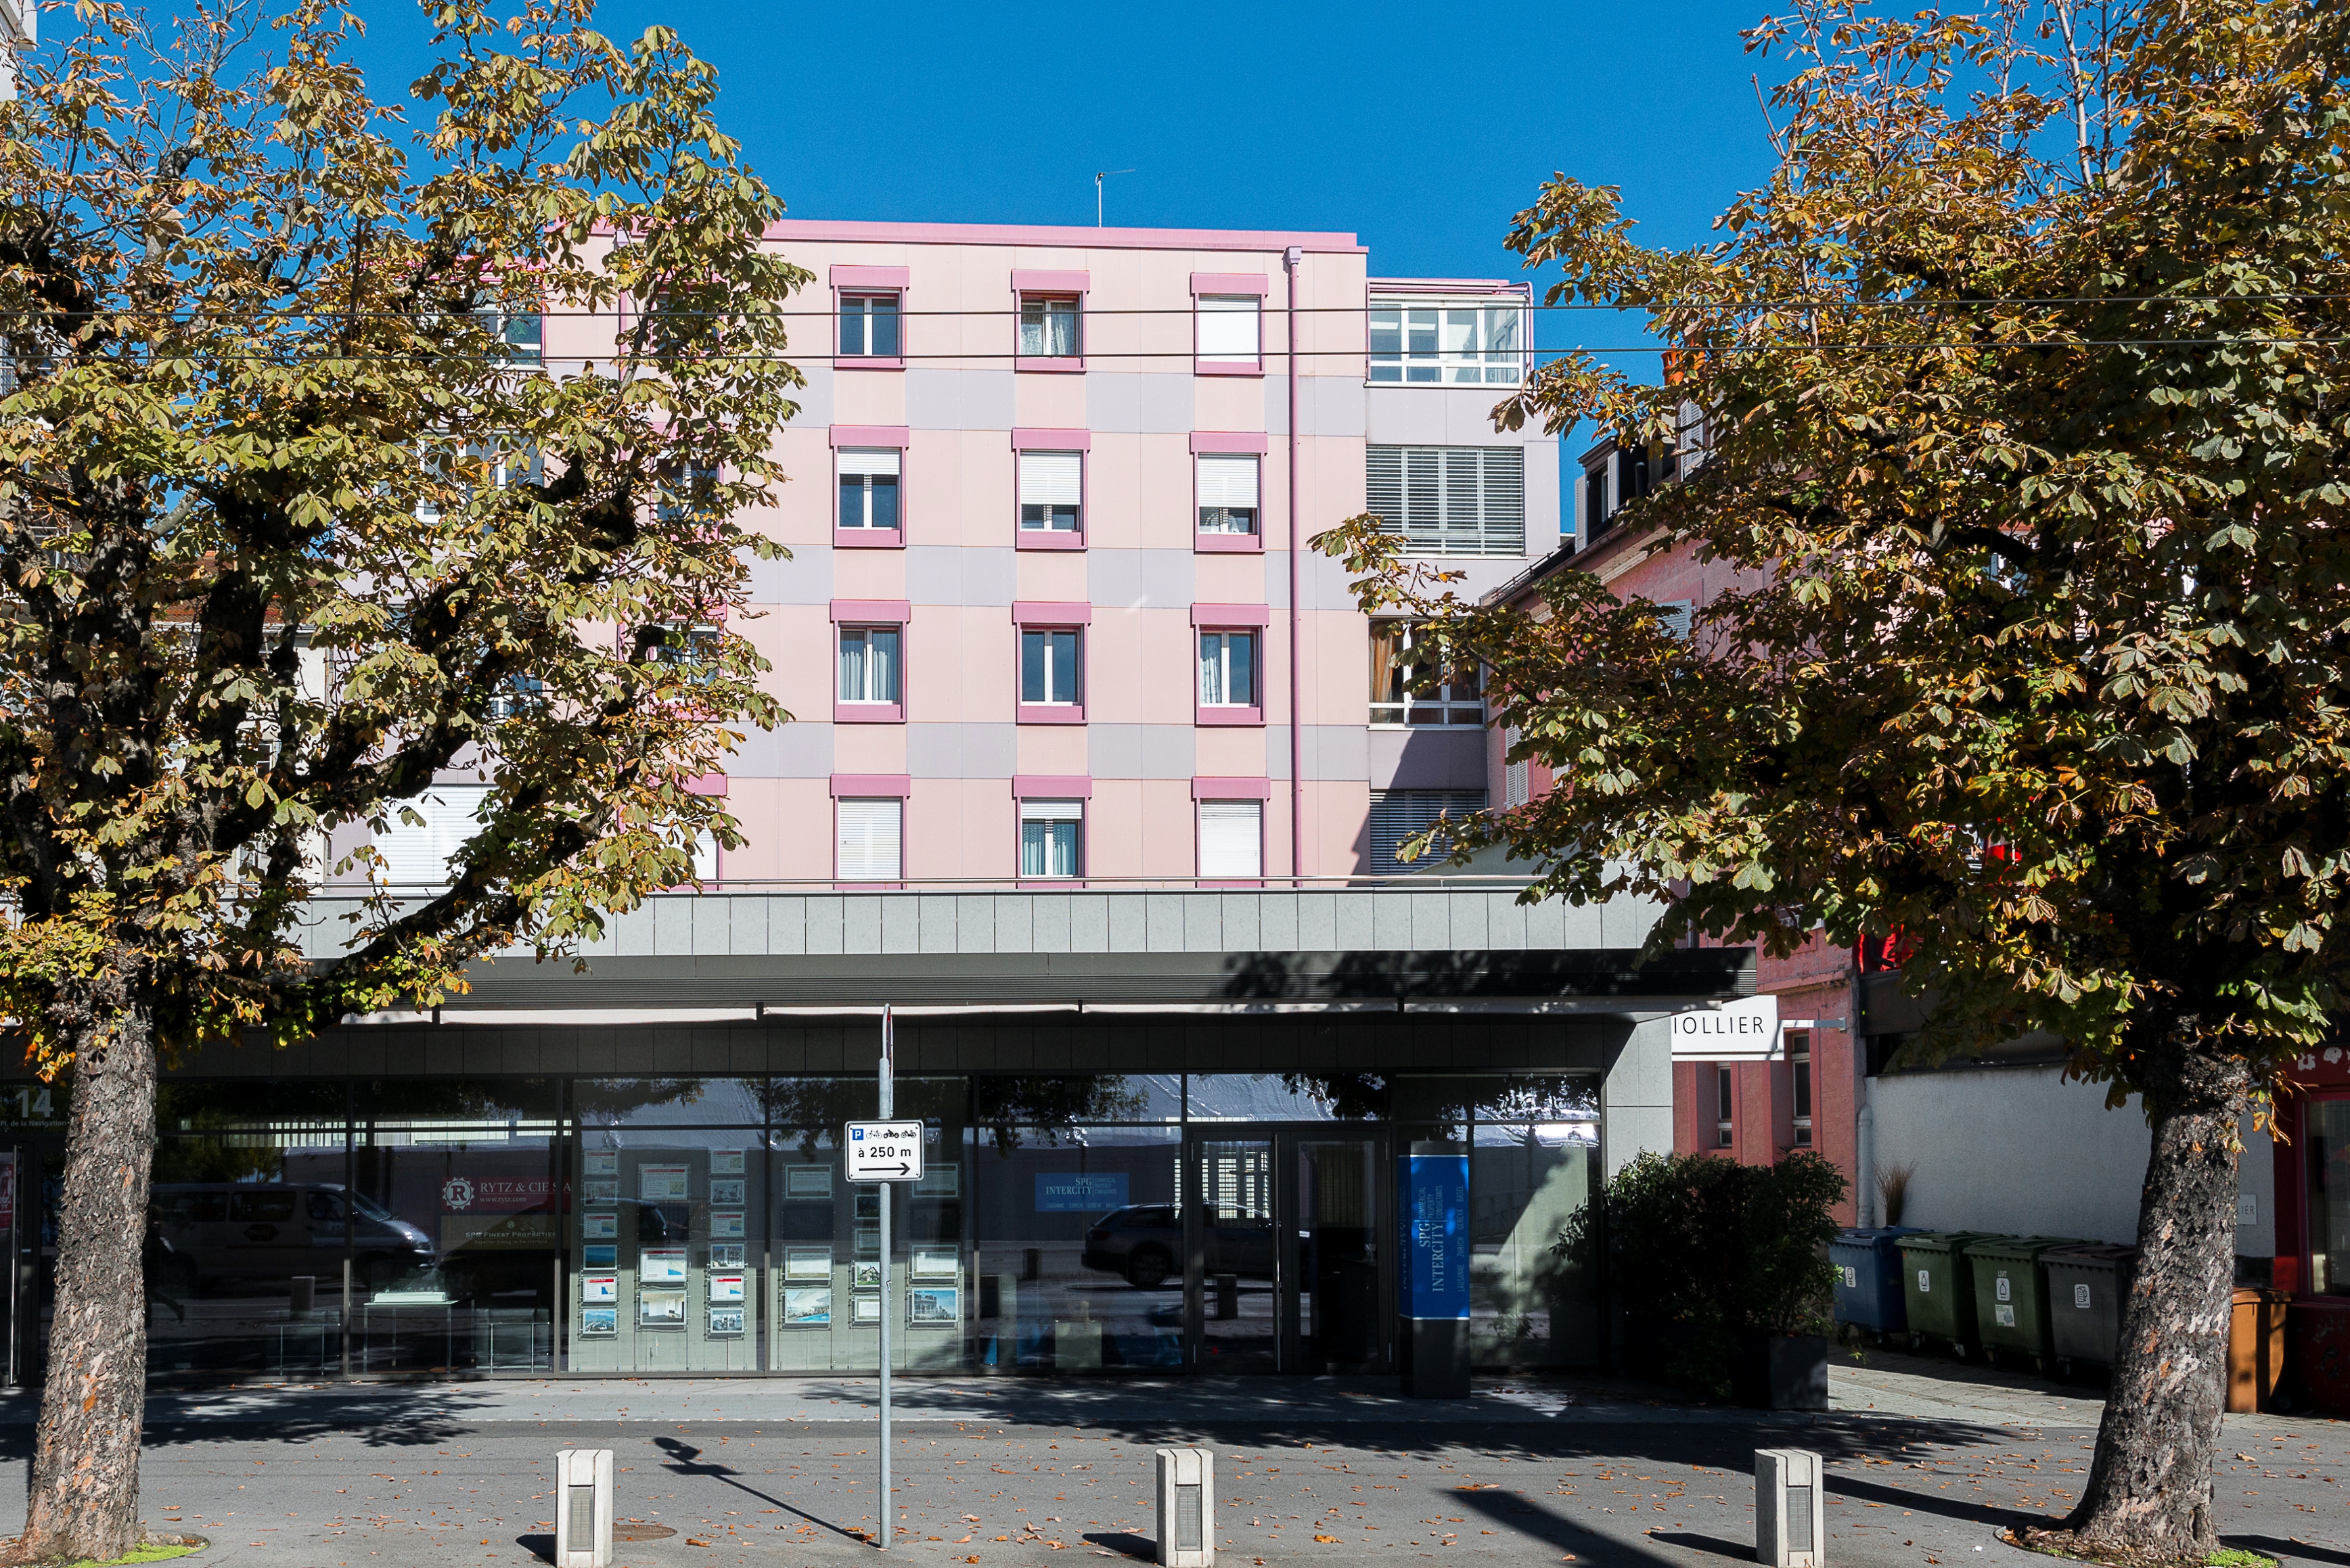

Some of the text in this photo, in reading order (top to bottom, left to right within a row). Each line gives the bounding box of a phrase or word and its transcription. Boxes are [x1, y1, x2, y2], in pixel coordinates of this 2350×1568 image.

[16, 1089, 54, 1118] 14
[855, 1130, 861, 1139] P
[858, 1147, 911, 1157] à 250 m
[480, 1182, 512, 1192] RYTZ
[516, 1182, 525, 1192] &
[528, 1182, 549, 1192] CIE
[1075, 1177, 1092, 1186] SPG
[451, 1185, 467, 1201] R
[1046, 1186, 1092, 1195] INTERCITY
[1455, 1185, 1464, 1202] BASEL
[1435, 1185, 1443, 1219] CONSULTANTS
[1456, 1209, 1464, 1230] GENEVA
[1419, 1222, 1431, 1247] SPG
[1432, 1223, 1444, 1292] INTERCITY
